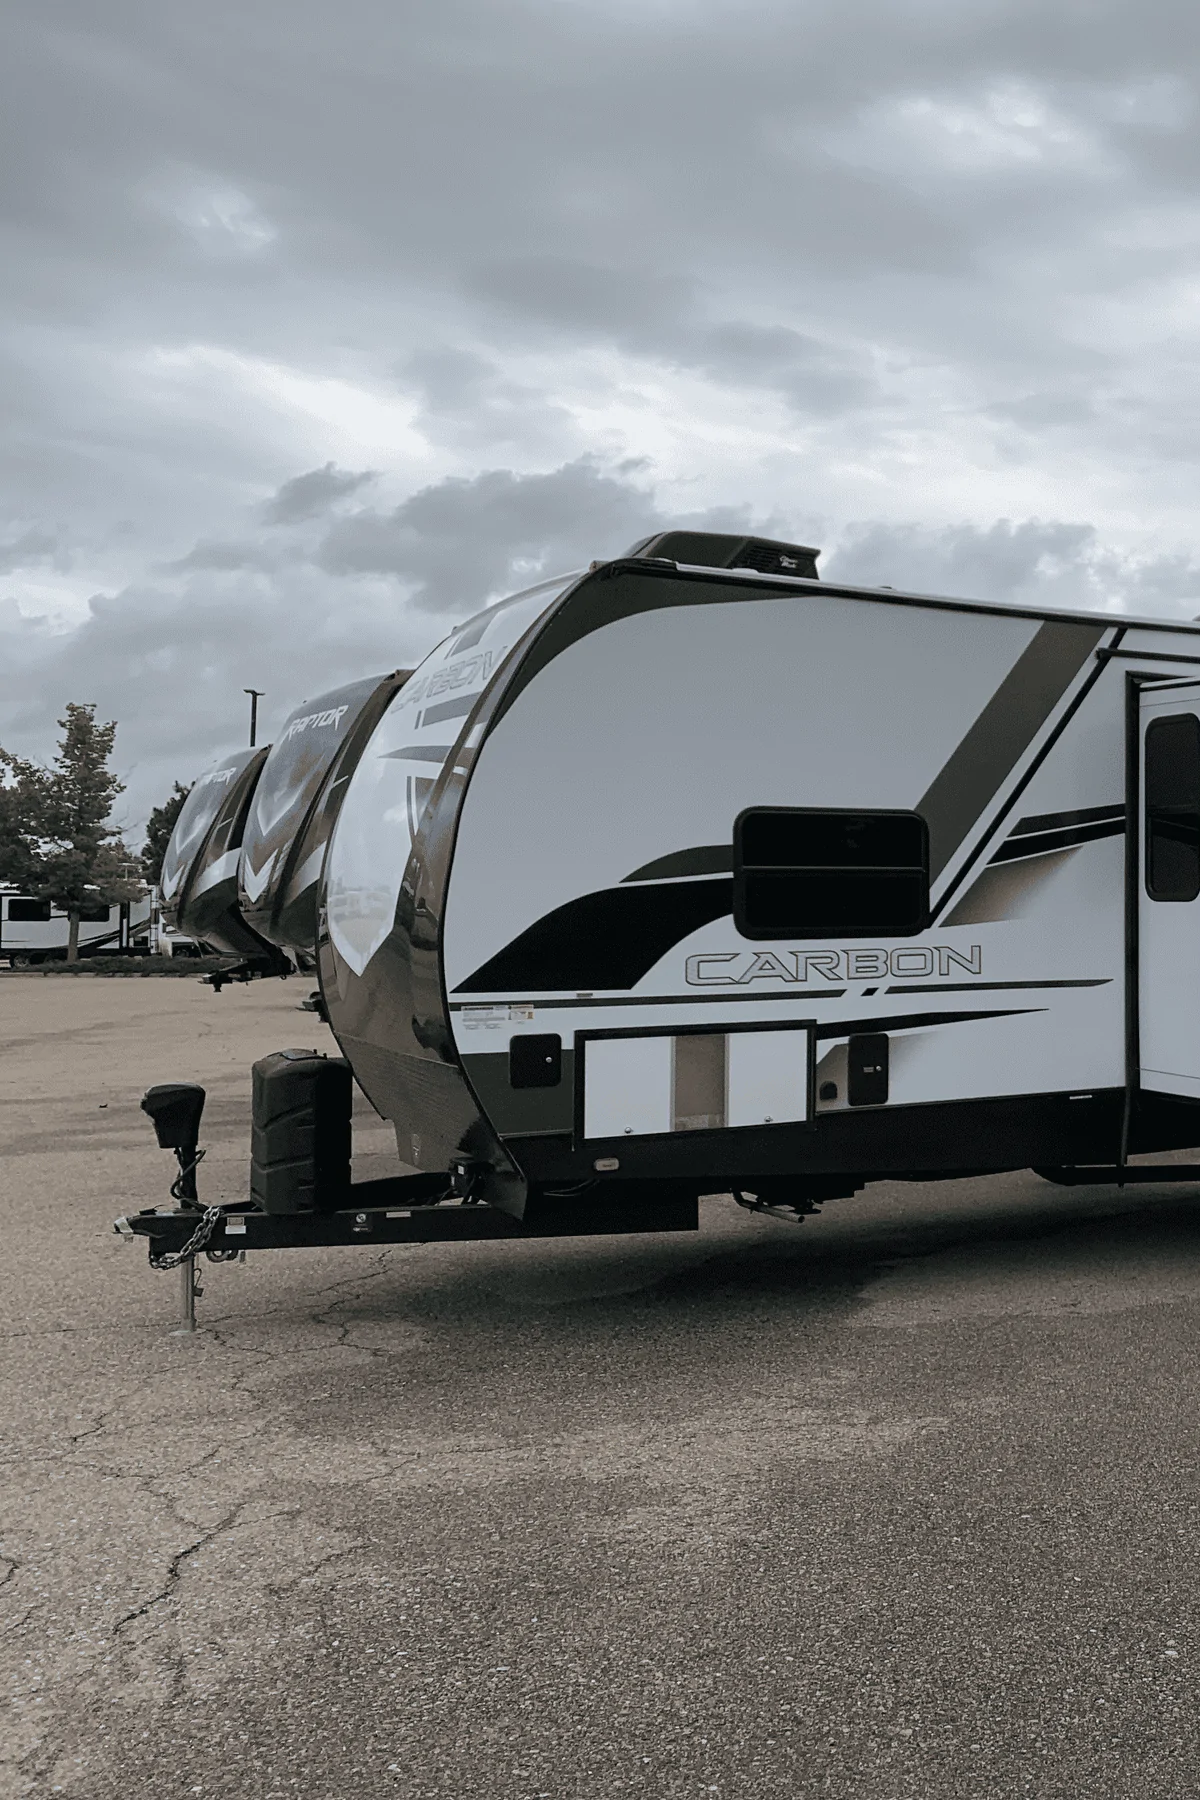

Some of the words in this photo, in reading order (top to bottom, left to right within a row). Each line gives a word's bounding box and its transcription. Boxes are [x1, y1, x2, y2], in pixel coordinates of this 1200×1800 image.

[281, 705, 349, 741] RAPTOR
[201, 767, 237, 786] PTOR
[685, 945, 982, 986] CARBON
